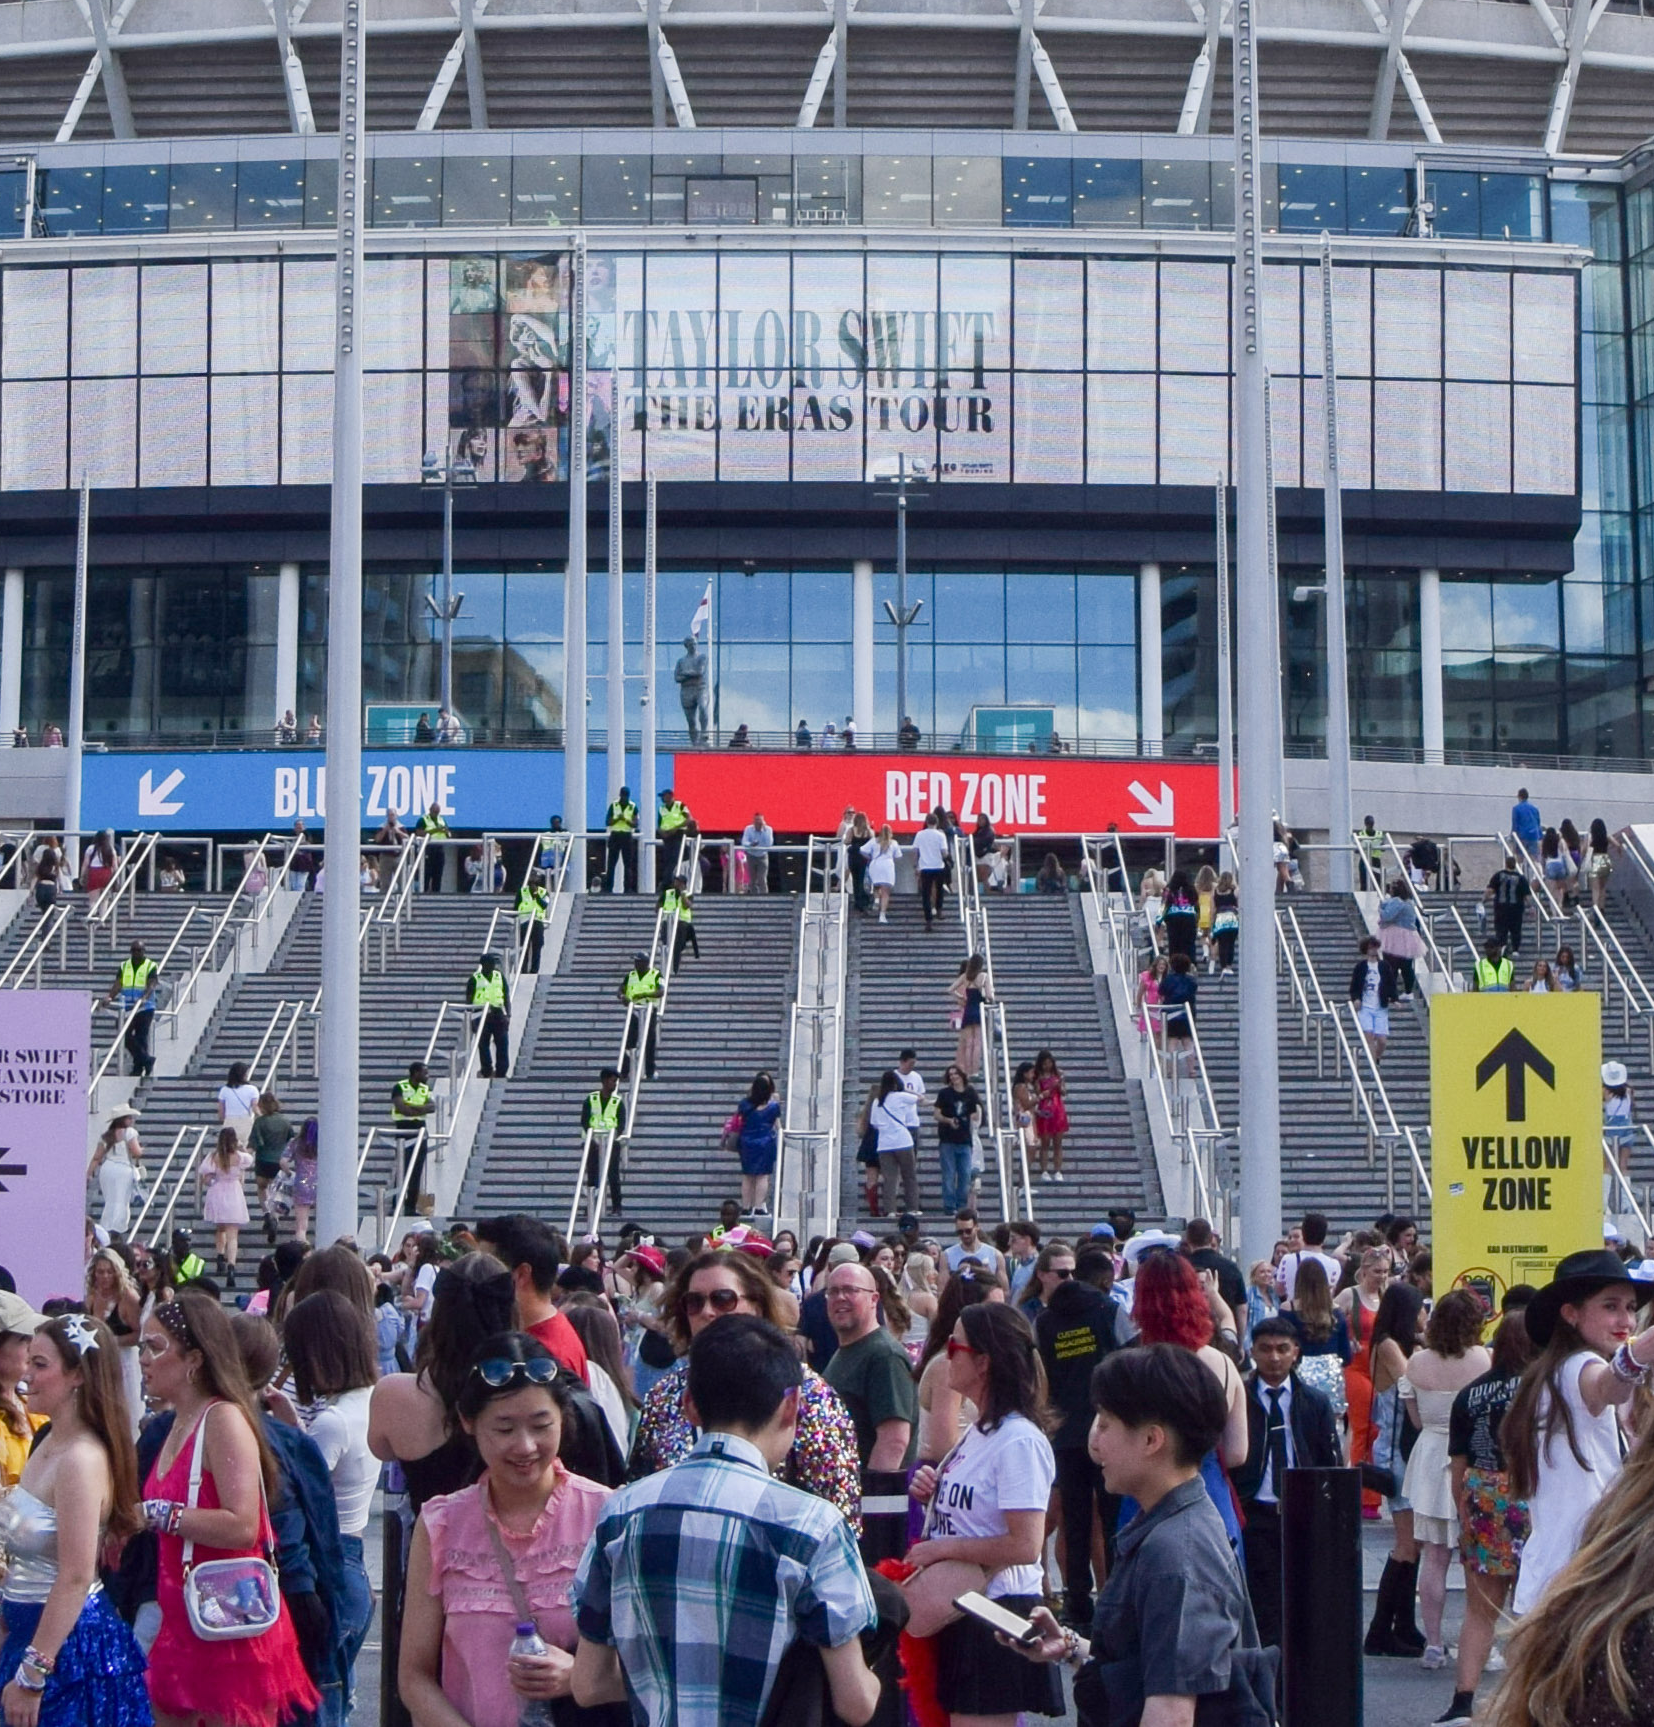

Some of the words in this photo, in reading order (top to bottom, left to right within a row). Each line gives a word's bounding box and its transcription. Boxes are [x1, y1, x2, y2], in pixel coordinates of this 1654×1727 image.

[624, 309, 822, 389] TAYLOR
[838, 309, 994, 390] SWIFT
[625, 395, 721, 431] THE
[736, 395, 853, 431] ERAS
[870, 395, 994, 432] TOUR
[366, 765, 456, 816] ZONE
[886, 770, 951, 821] RED
[960, 773, 1047, 825] ZONE
[15, 1049, 78, 1064] SWIFT
[1462, 1136, 1571, 1169] YELLOW
[1483, 1177, 1551, 1210] ZONE
[949, 1482, 974, 1510] ON
